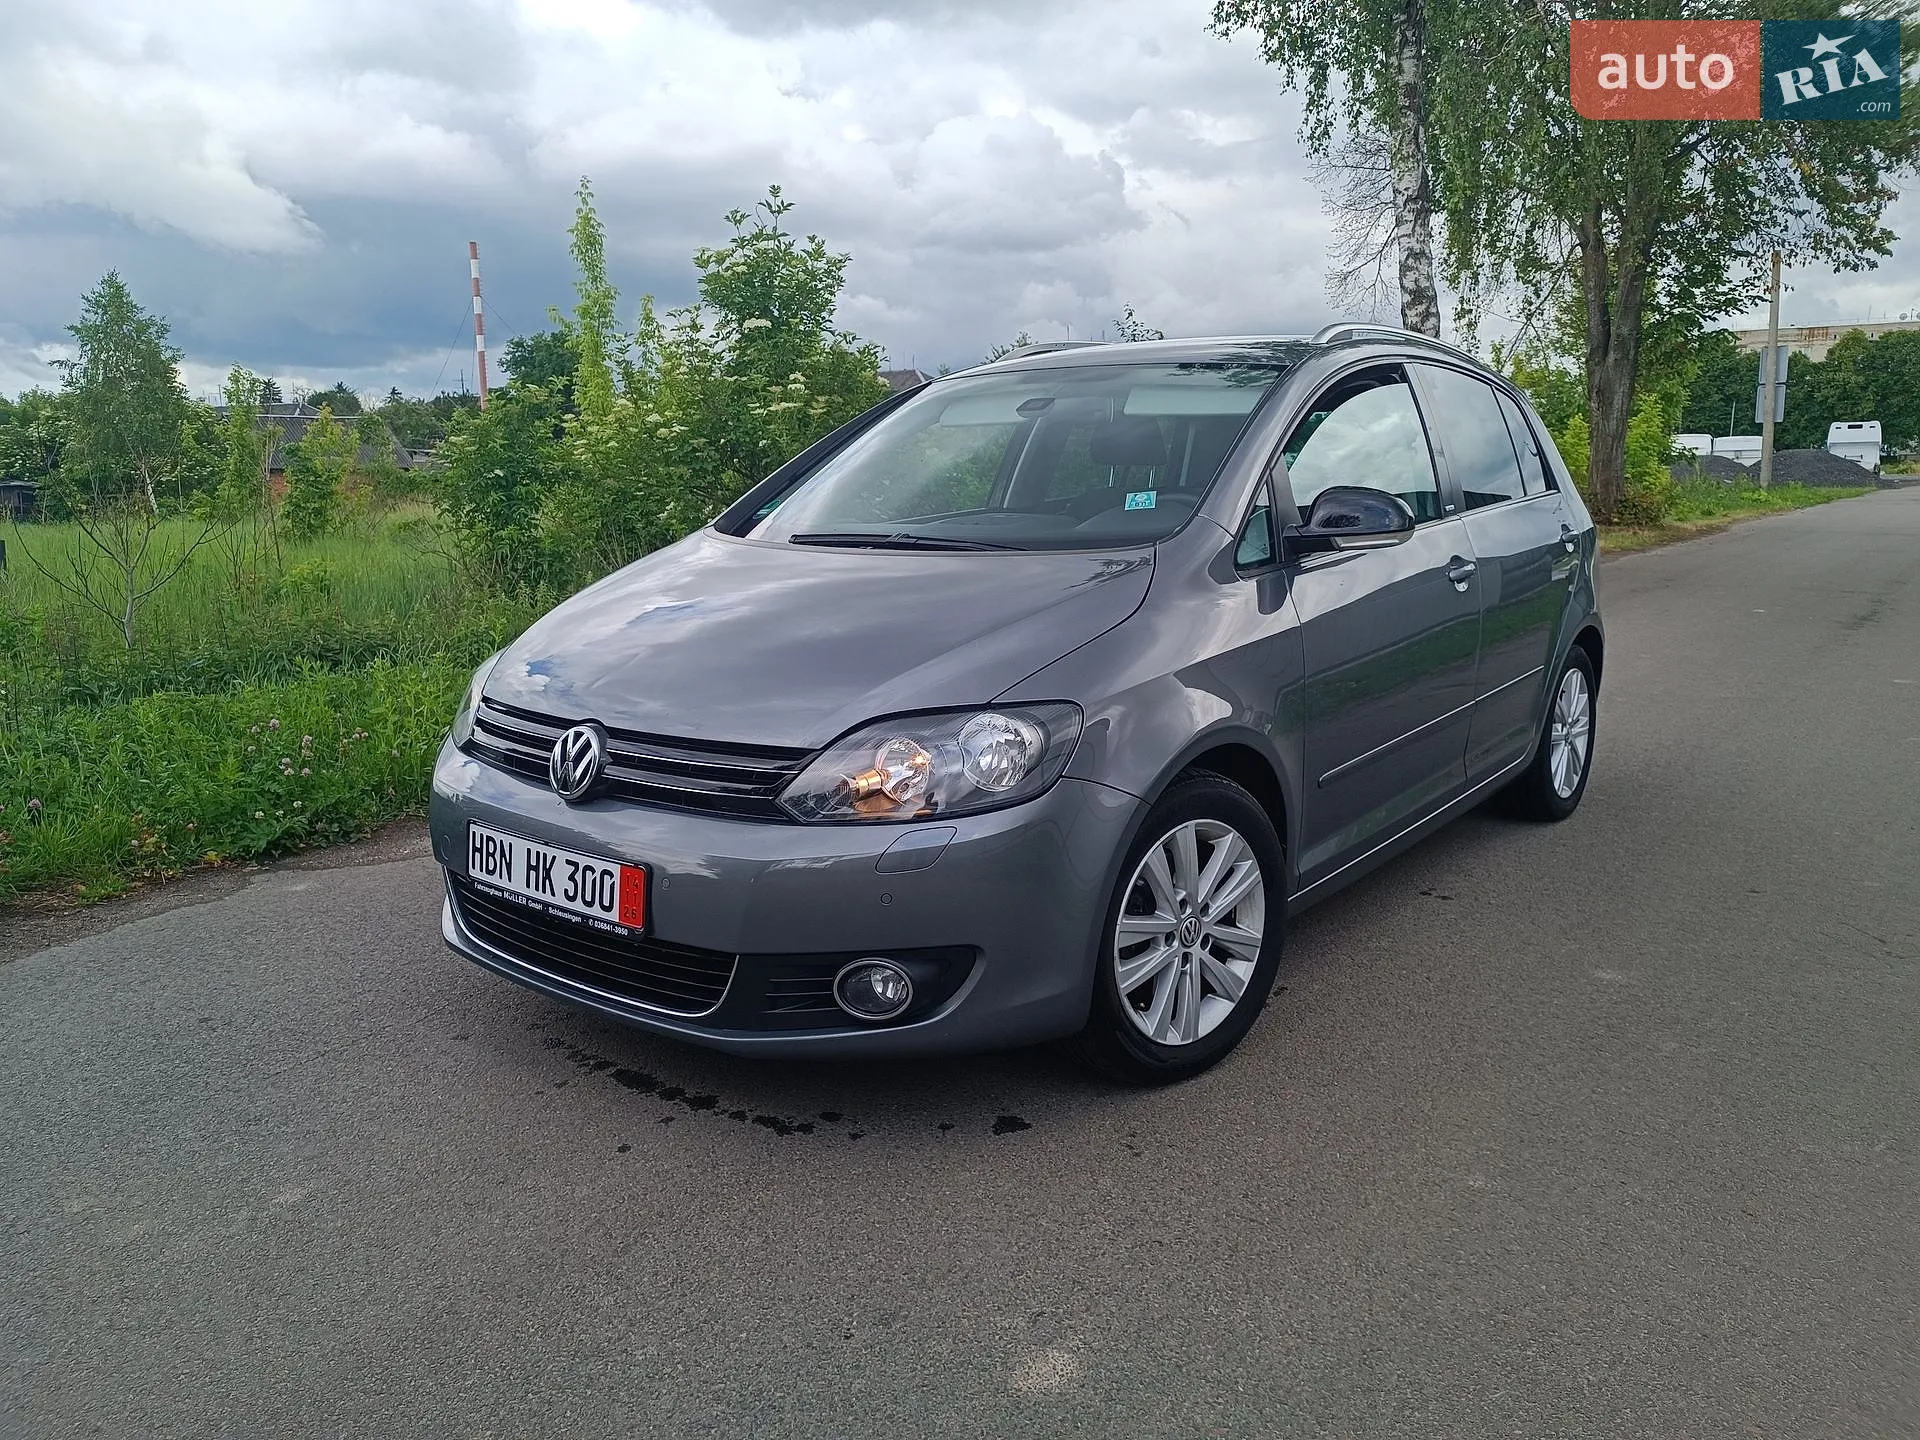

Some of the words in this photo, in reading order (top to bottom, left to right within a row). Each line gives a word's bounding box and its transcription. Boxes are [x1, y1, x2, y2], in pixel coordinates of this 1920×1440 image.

[550, 726, 599, 799] VW
[471, 830, 513, 883] HBN
[526, 847, 558, 898] HK
[564, 859, 615, 913] 300
[1181, 916, 1201, 947] VW
